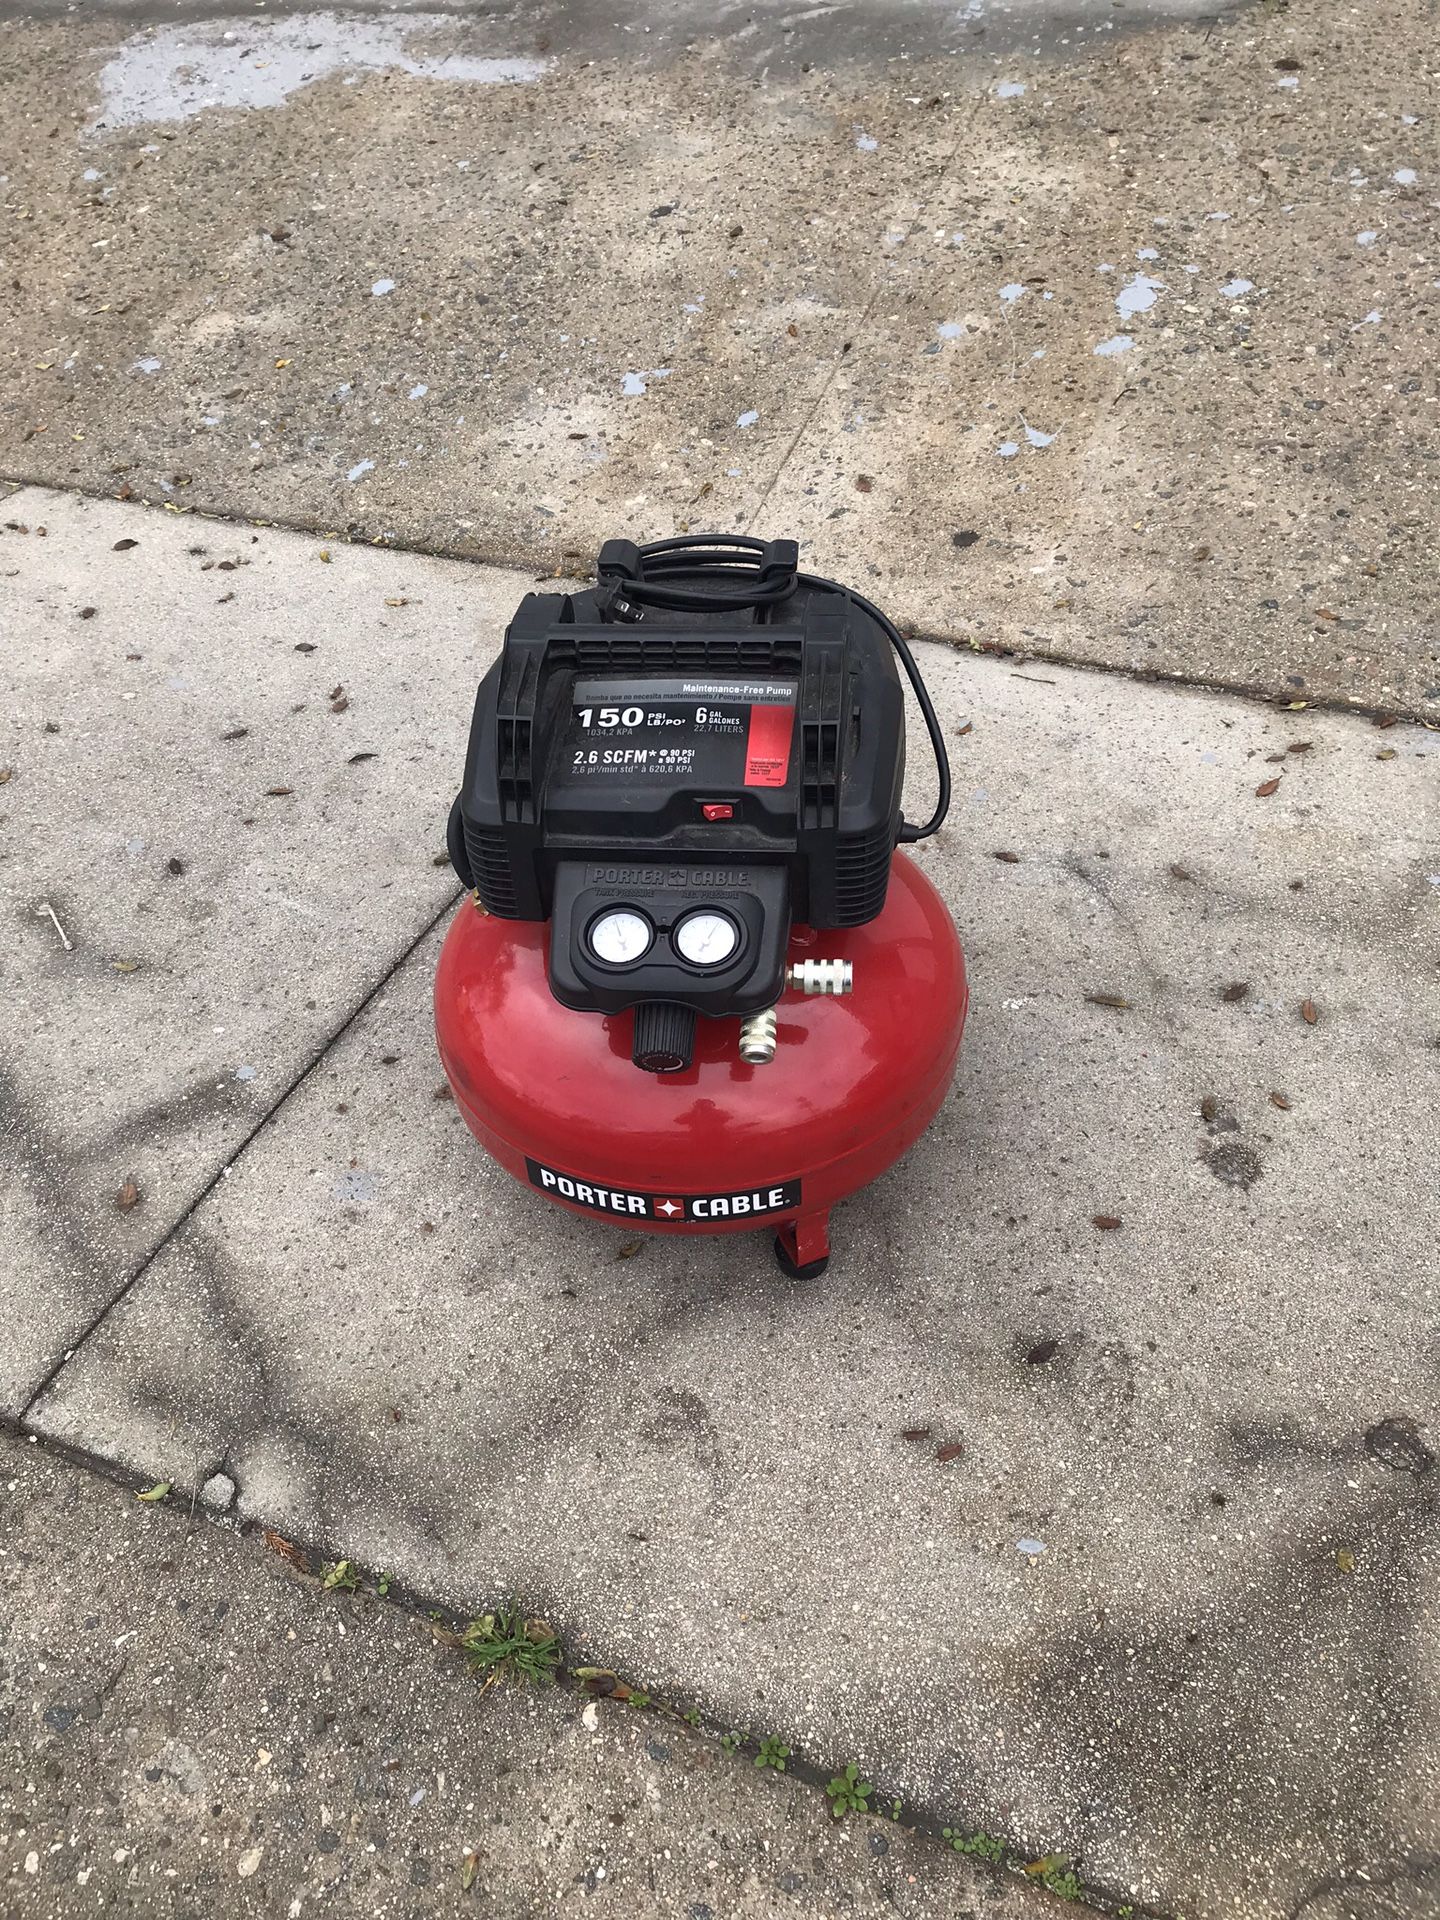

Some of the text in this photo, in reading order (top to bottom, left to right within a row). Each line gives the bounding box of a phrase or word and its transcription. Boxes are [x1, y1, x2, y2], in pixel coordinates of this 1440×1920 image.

[683, 684, 792, 696] Maintenance-Free Pump
[663, 692, 712, 700] mantenimiento
[719, 694, 741, 702] Pompe
[578, 707, 644, 728] 150
[695, 707, 708, 724] 6
[708, 717, 740, 725] GALONES
[714, 725, 744, 733] LITERS
[573, 750, 598, 764] 2.6
[670, 749, 680, 757] 90
[682, 749, 695, 757] PSI
[675, 765, 693, 773] KPA
[592, 868, 750, 887] PORTER CABLE
[540, 1168, 784, 1217] PORTER CABLE
